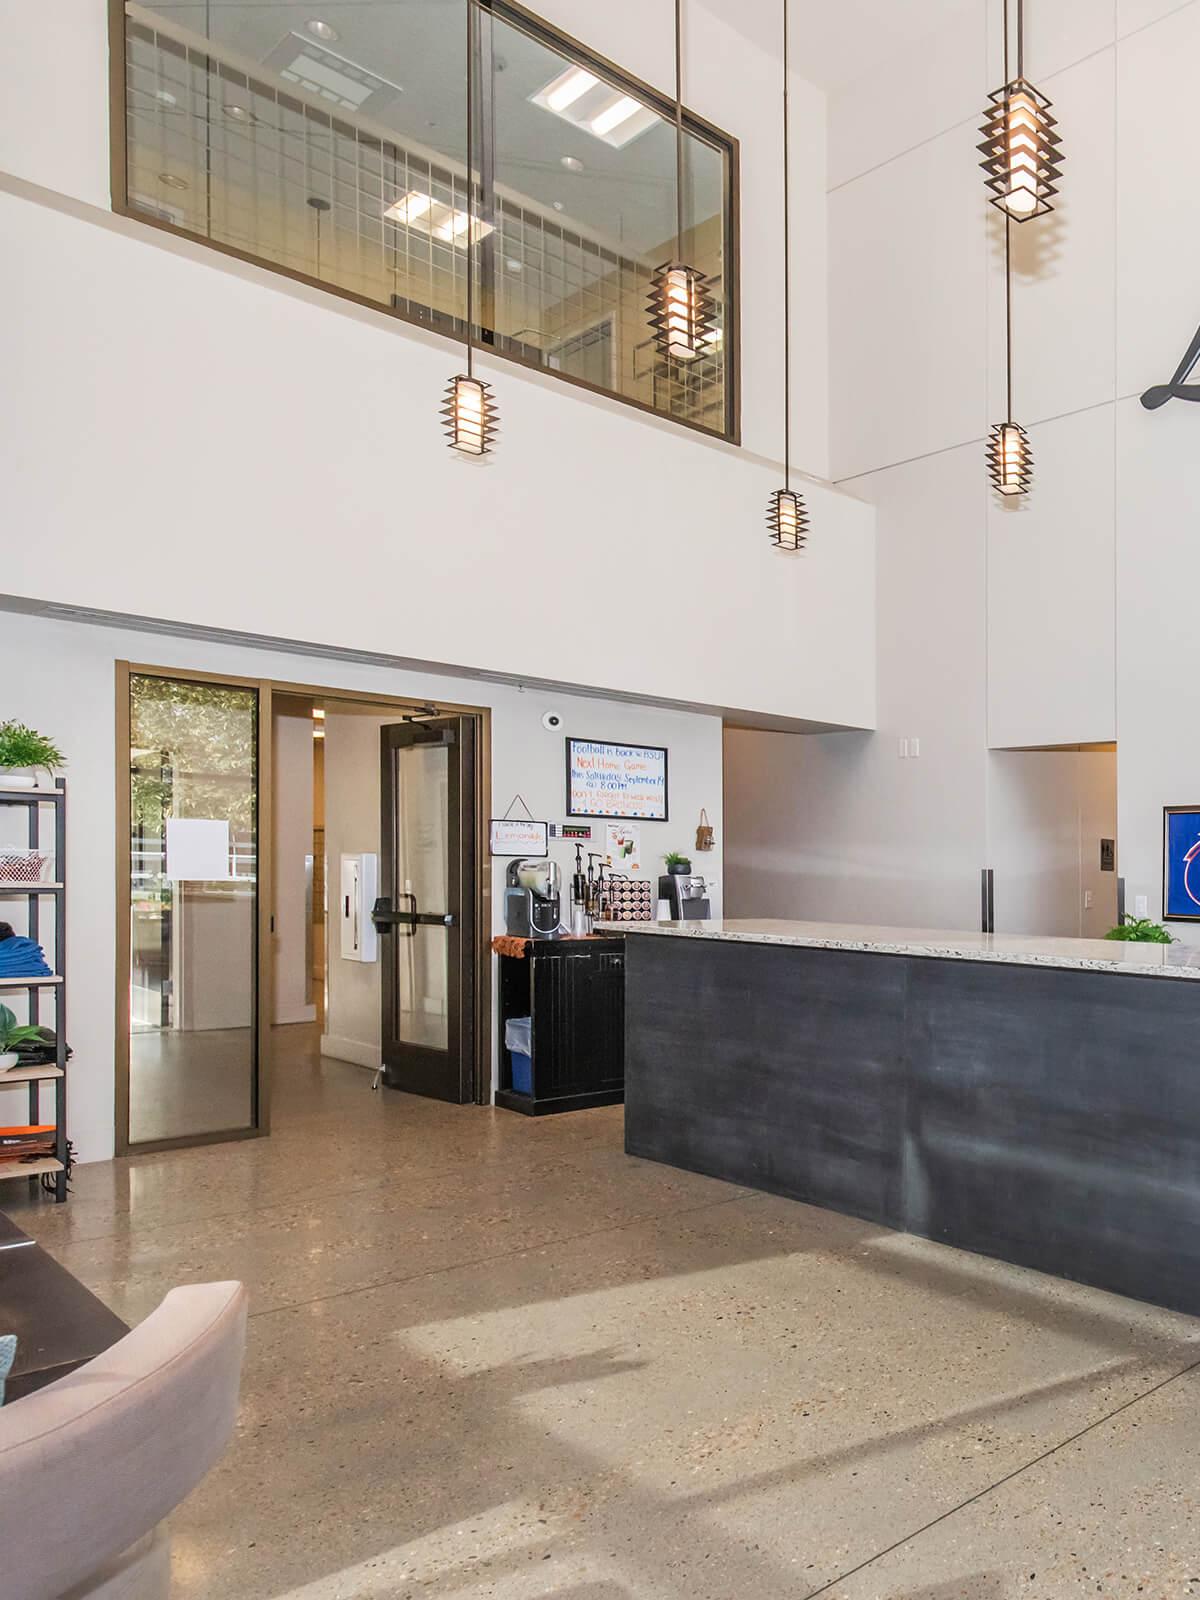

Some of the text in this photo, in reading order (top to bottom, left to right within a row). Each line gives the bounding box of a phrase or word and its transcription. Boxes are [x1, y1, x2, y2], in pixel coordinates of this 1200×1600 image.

[576, 755, 647, 770] Next Home Game
